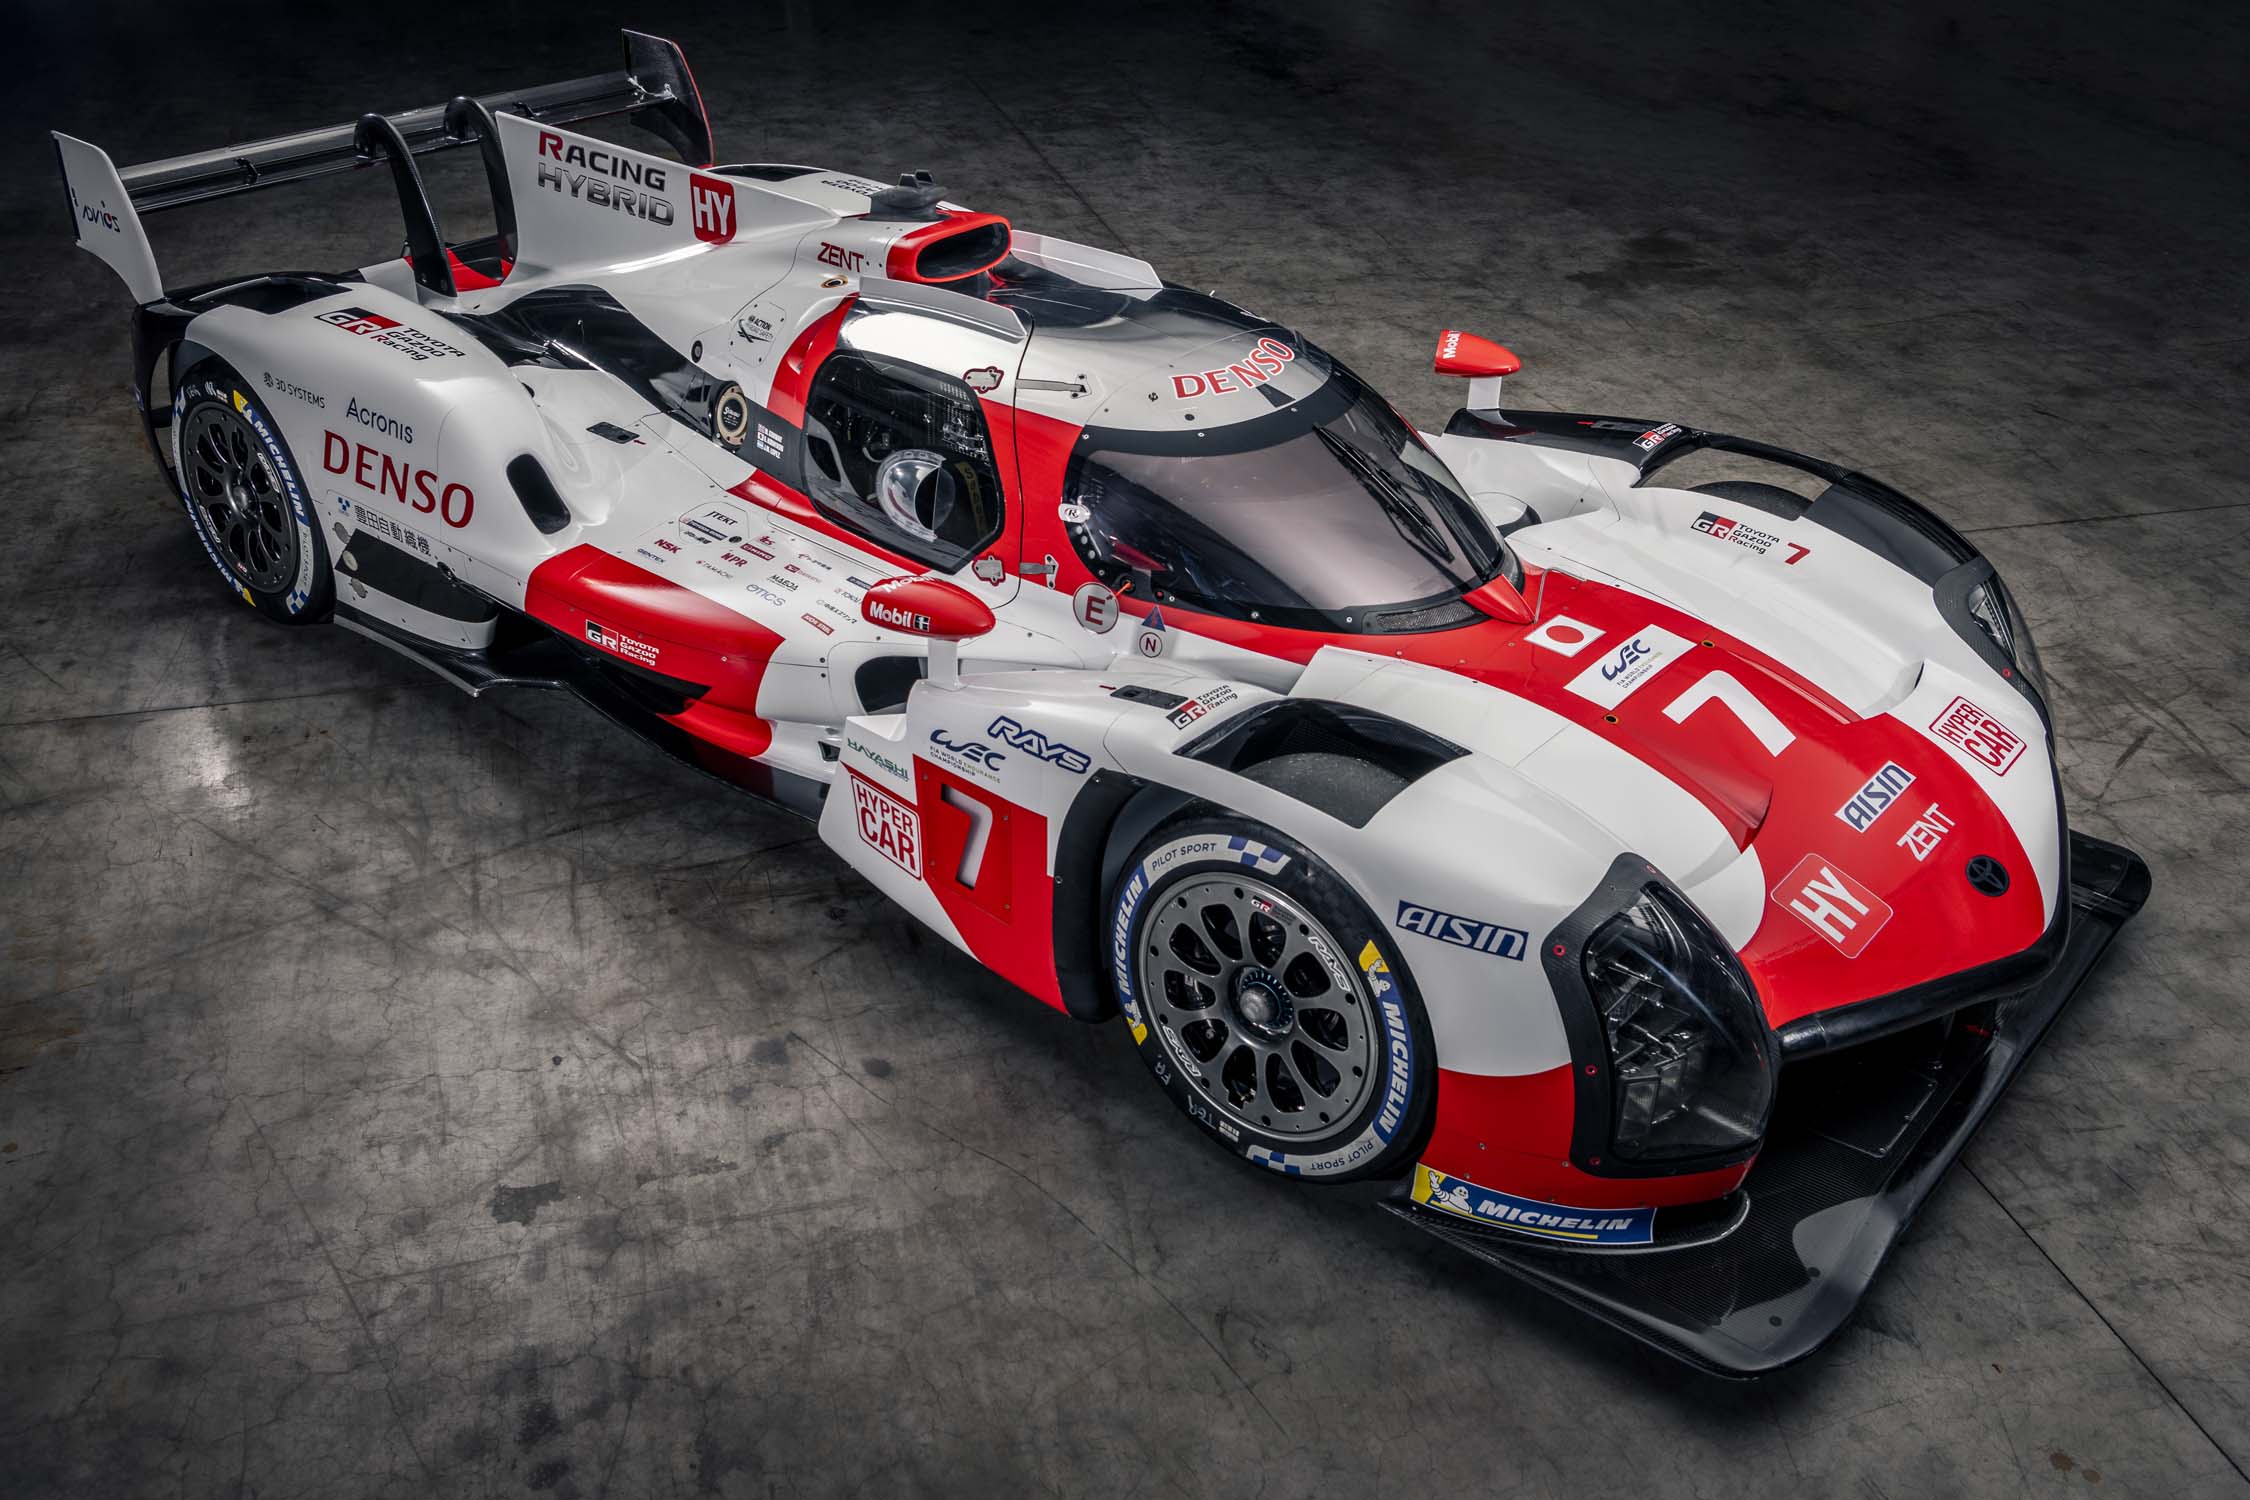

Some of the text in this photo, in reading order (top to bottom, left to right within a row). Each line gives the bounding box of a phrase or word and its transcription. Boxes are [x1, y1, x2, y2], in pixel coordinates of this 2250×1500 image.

[539, 131, 666, 192] RACING
[537, 162, 674, 226] HYBRID
[693, 186, 731, 236] HY
[817, 241, 865, 273] ZENT
[319, 312, 382, 335] GR
[370, 334, 429, 361] Racing
[385, 331, 446, 357] GAZOO
[404, 327, 466, 357] TOYOTA
[1170, 337, 1295, 399] DENSO
[275, 378, 325, 409] 3D SYSTEMS
[346, 397, 413, 444] Acronis
[254, 420, 305, 517] MICHELIN
[323, 430, 475, 529] DENSO
[704, 510, 738, 526] JTEKT
[1692, 518, 1730, 538] GR
[1739, 524, 1780, 543] TOYOTA
[654, 539, 682, 554] NSK
[1728, 535, 1767, 555] Racing
[1733, 529, 1772, 548] GAZOO
[1784, 542, 1811, 565] 7
[721, 552, 748, 567] NPR
[746, 584, 786, 606] OTICS
[1085, 595, 1106, 626] E
[869, 601, 912, 627] Mobil
[588, 630, 617, 650] GR
[620, 634, 660, 654] TOYOTA
[620, 641, 656, 659] GAZOO
[1145, 637, 1157, 653] N
[620, 647, 656, 666] Racing
[1601, 638, 1651, 681] WEC
[1197, 685, 1230, 700] TOYOTA
[1202, 688, 1232, 705] GAZOO
[1207, 692, 1238, 710] Racing
[1661, 669, 1797, 758] 7
[1937, 703, 1985, 744] HYPER
[847, 738, 908, 779] HAYASHI
[930, 729, 1006, 771] WEC
[941, 750, 963, 765] WORLD
[987, 715, 1092, 774] RAYS
[1963, 718, 2020, 768] CAR
[930, 752, 976, 777] CHAMPIONSHIP
[856, 782, 914, 837] HYPER
[1843, 763, 1913, 831] AISIN
[860, 806, 916, 871] CAR
[941, 783, 993, 891] 7
[1896, 802, 1956, 862] ZENT
[1152, 842, 1217, 871] PILOT SPORT
[1251, 899, 1271, 913] GR
[1790, 866, 1870, 944] HY
[1114, 874, 1144, 996] MICHELIN
[1398, 906, 1525, 958] AISIN
[1307, 936, 1351, 991] RAYS
[1378, 1001, 1409, 1134] MICHELIN
[1310, 1139, 1374, 1171] PILOT SPORT
[1476, 1199, 1633, 1231] MICHELIN
